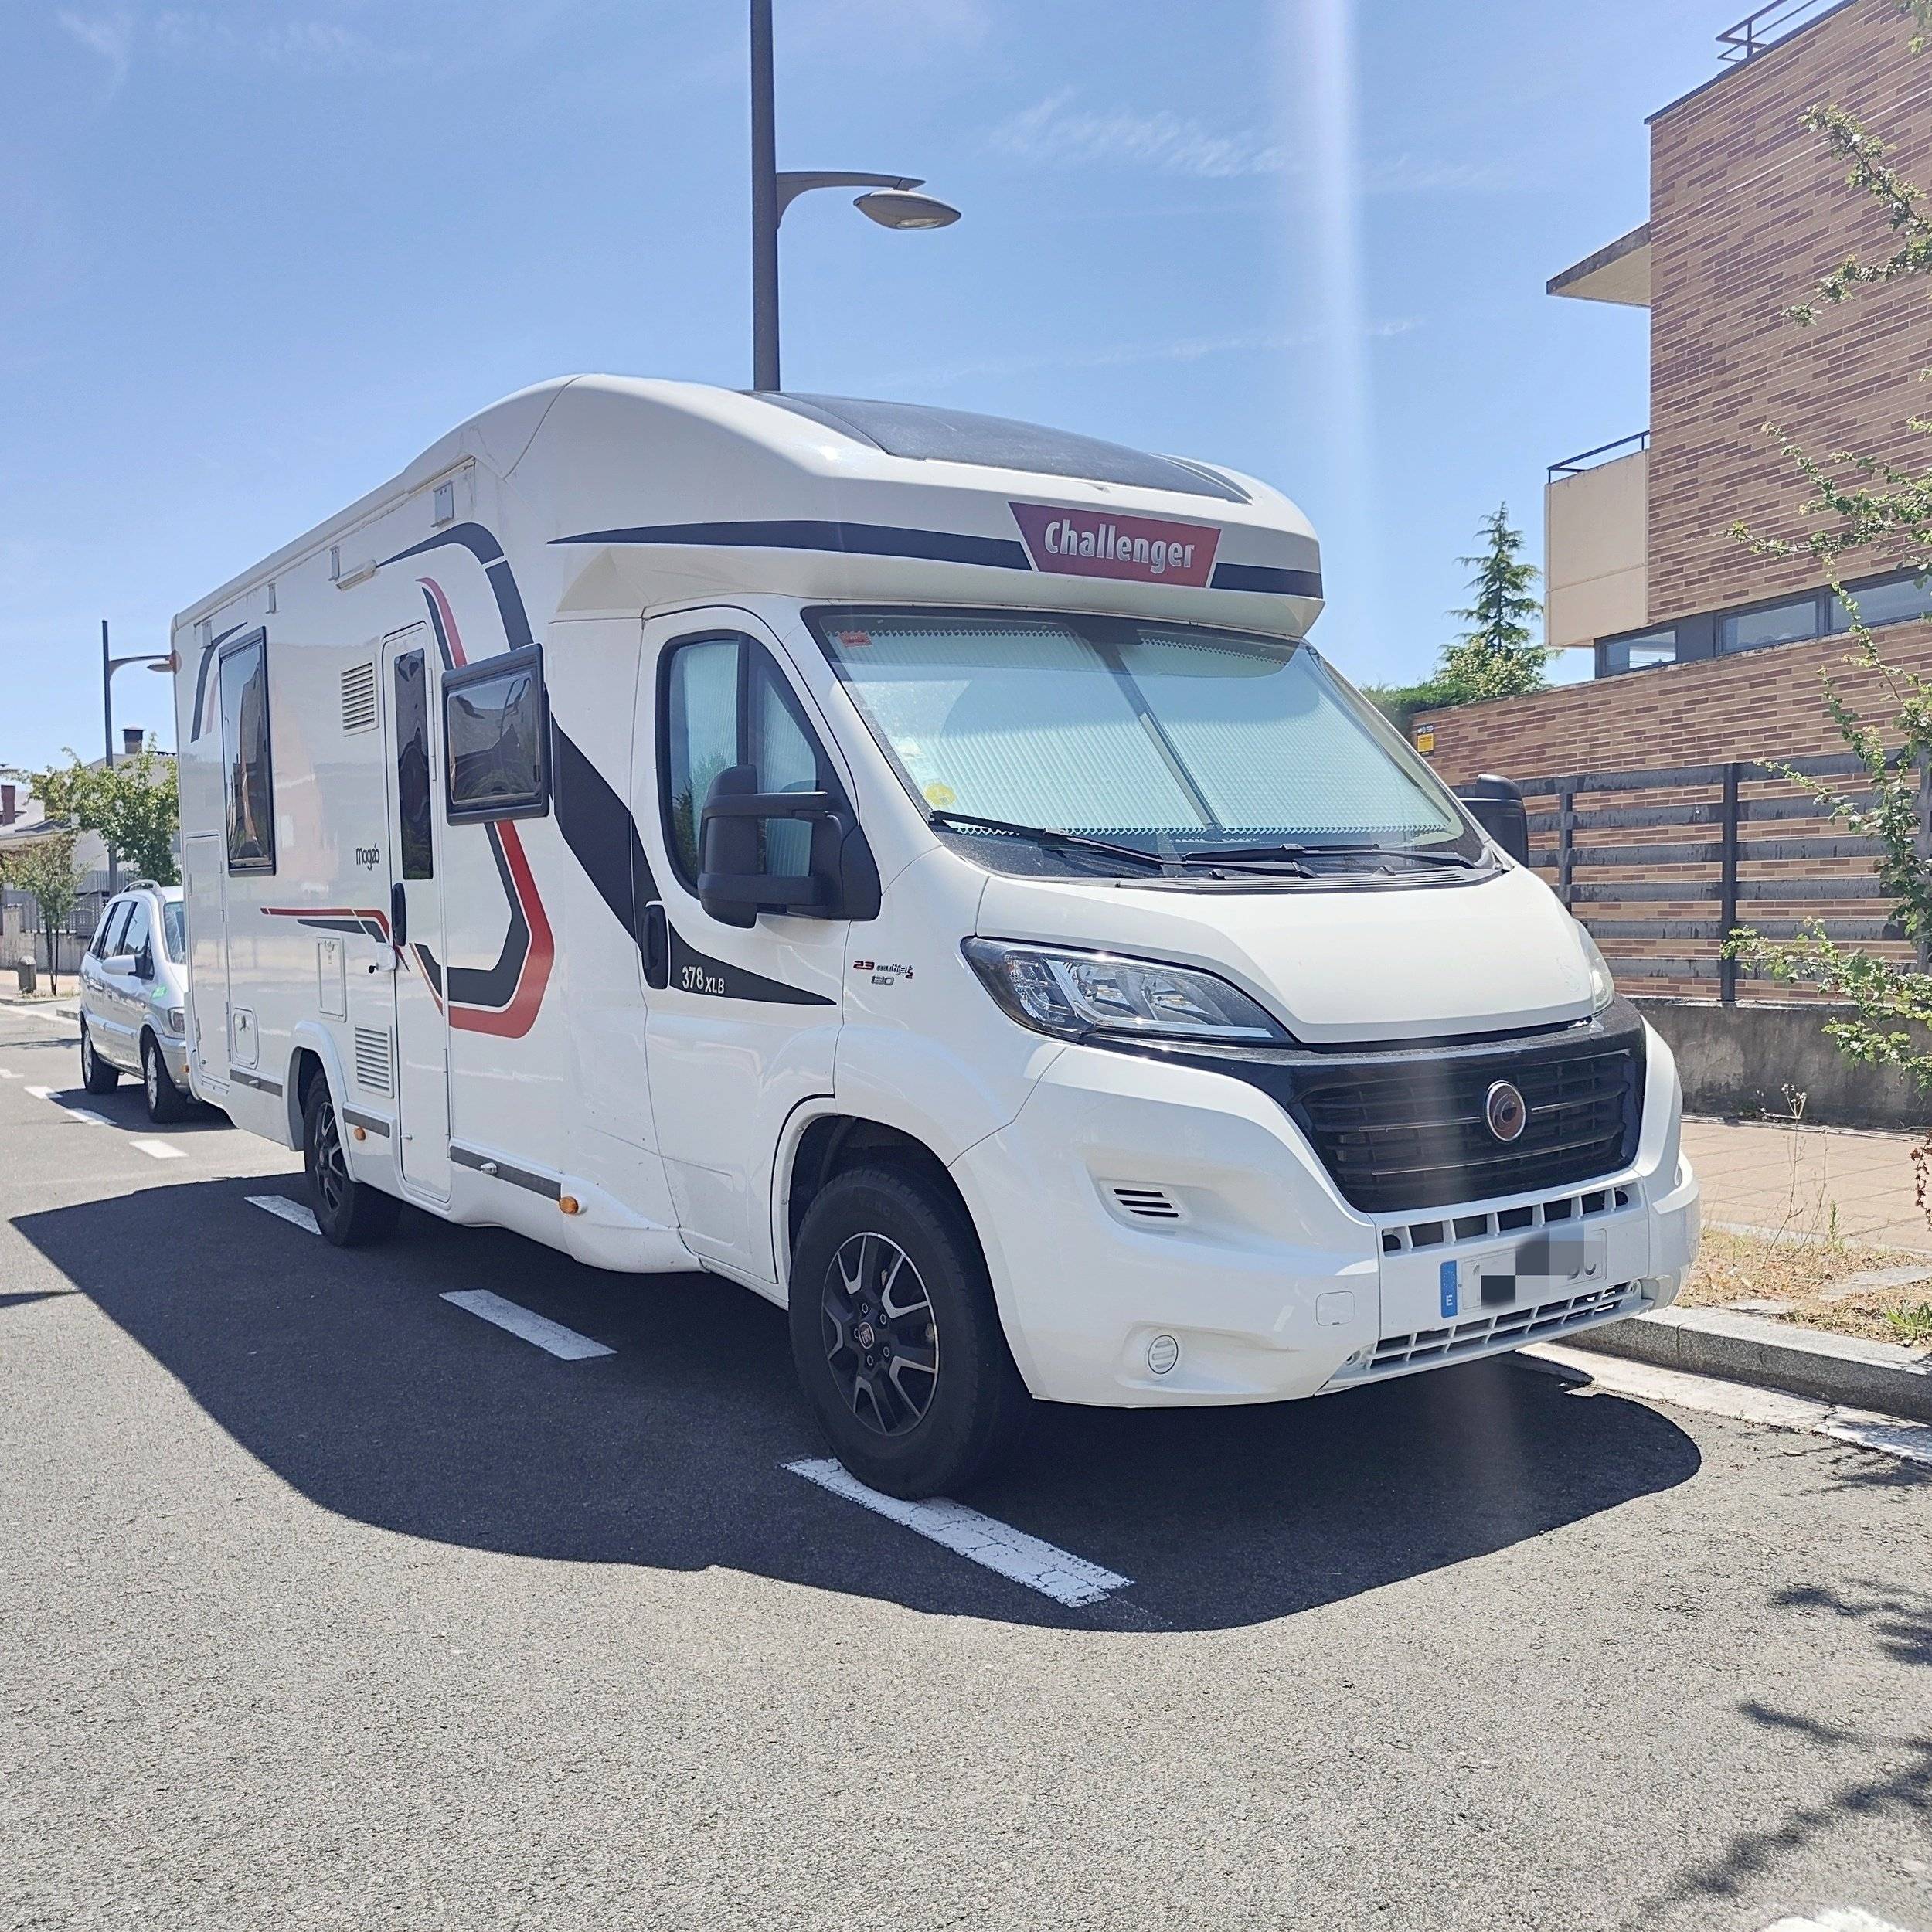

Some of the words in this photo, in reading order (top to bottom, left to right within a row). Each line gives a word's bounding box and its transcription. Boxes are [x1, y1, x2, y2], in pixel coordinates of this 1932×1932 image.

[1044, 519, 1195, 573] Challenger
[852, 961, 875, 971] 23
[682, 966, 704, 989] 378
[705, 976, 725, 994] XLB
[1446, 1294, 1453, 1306] E
